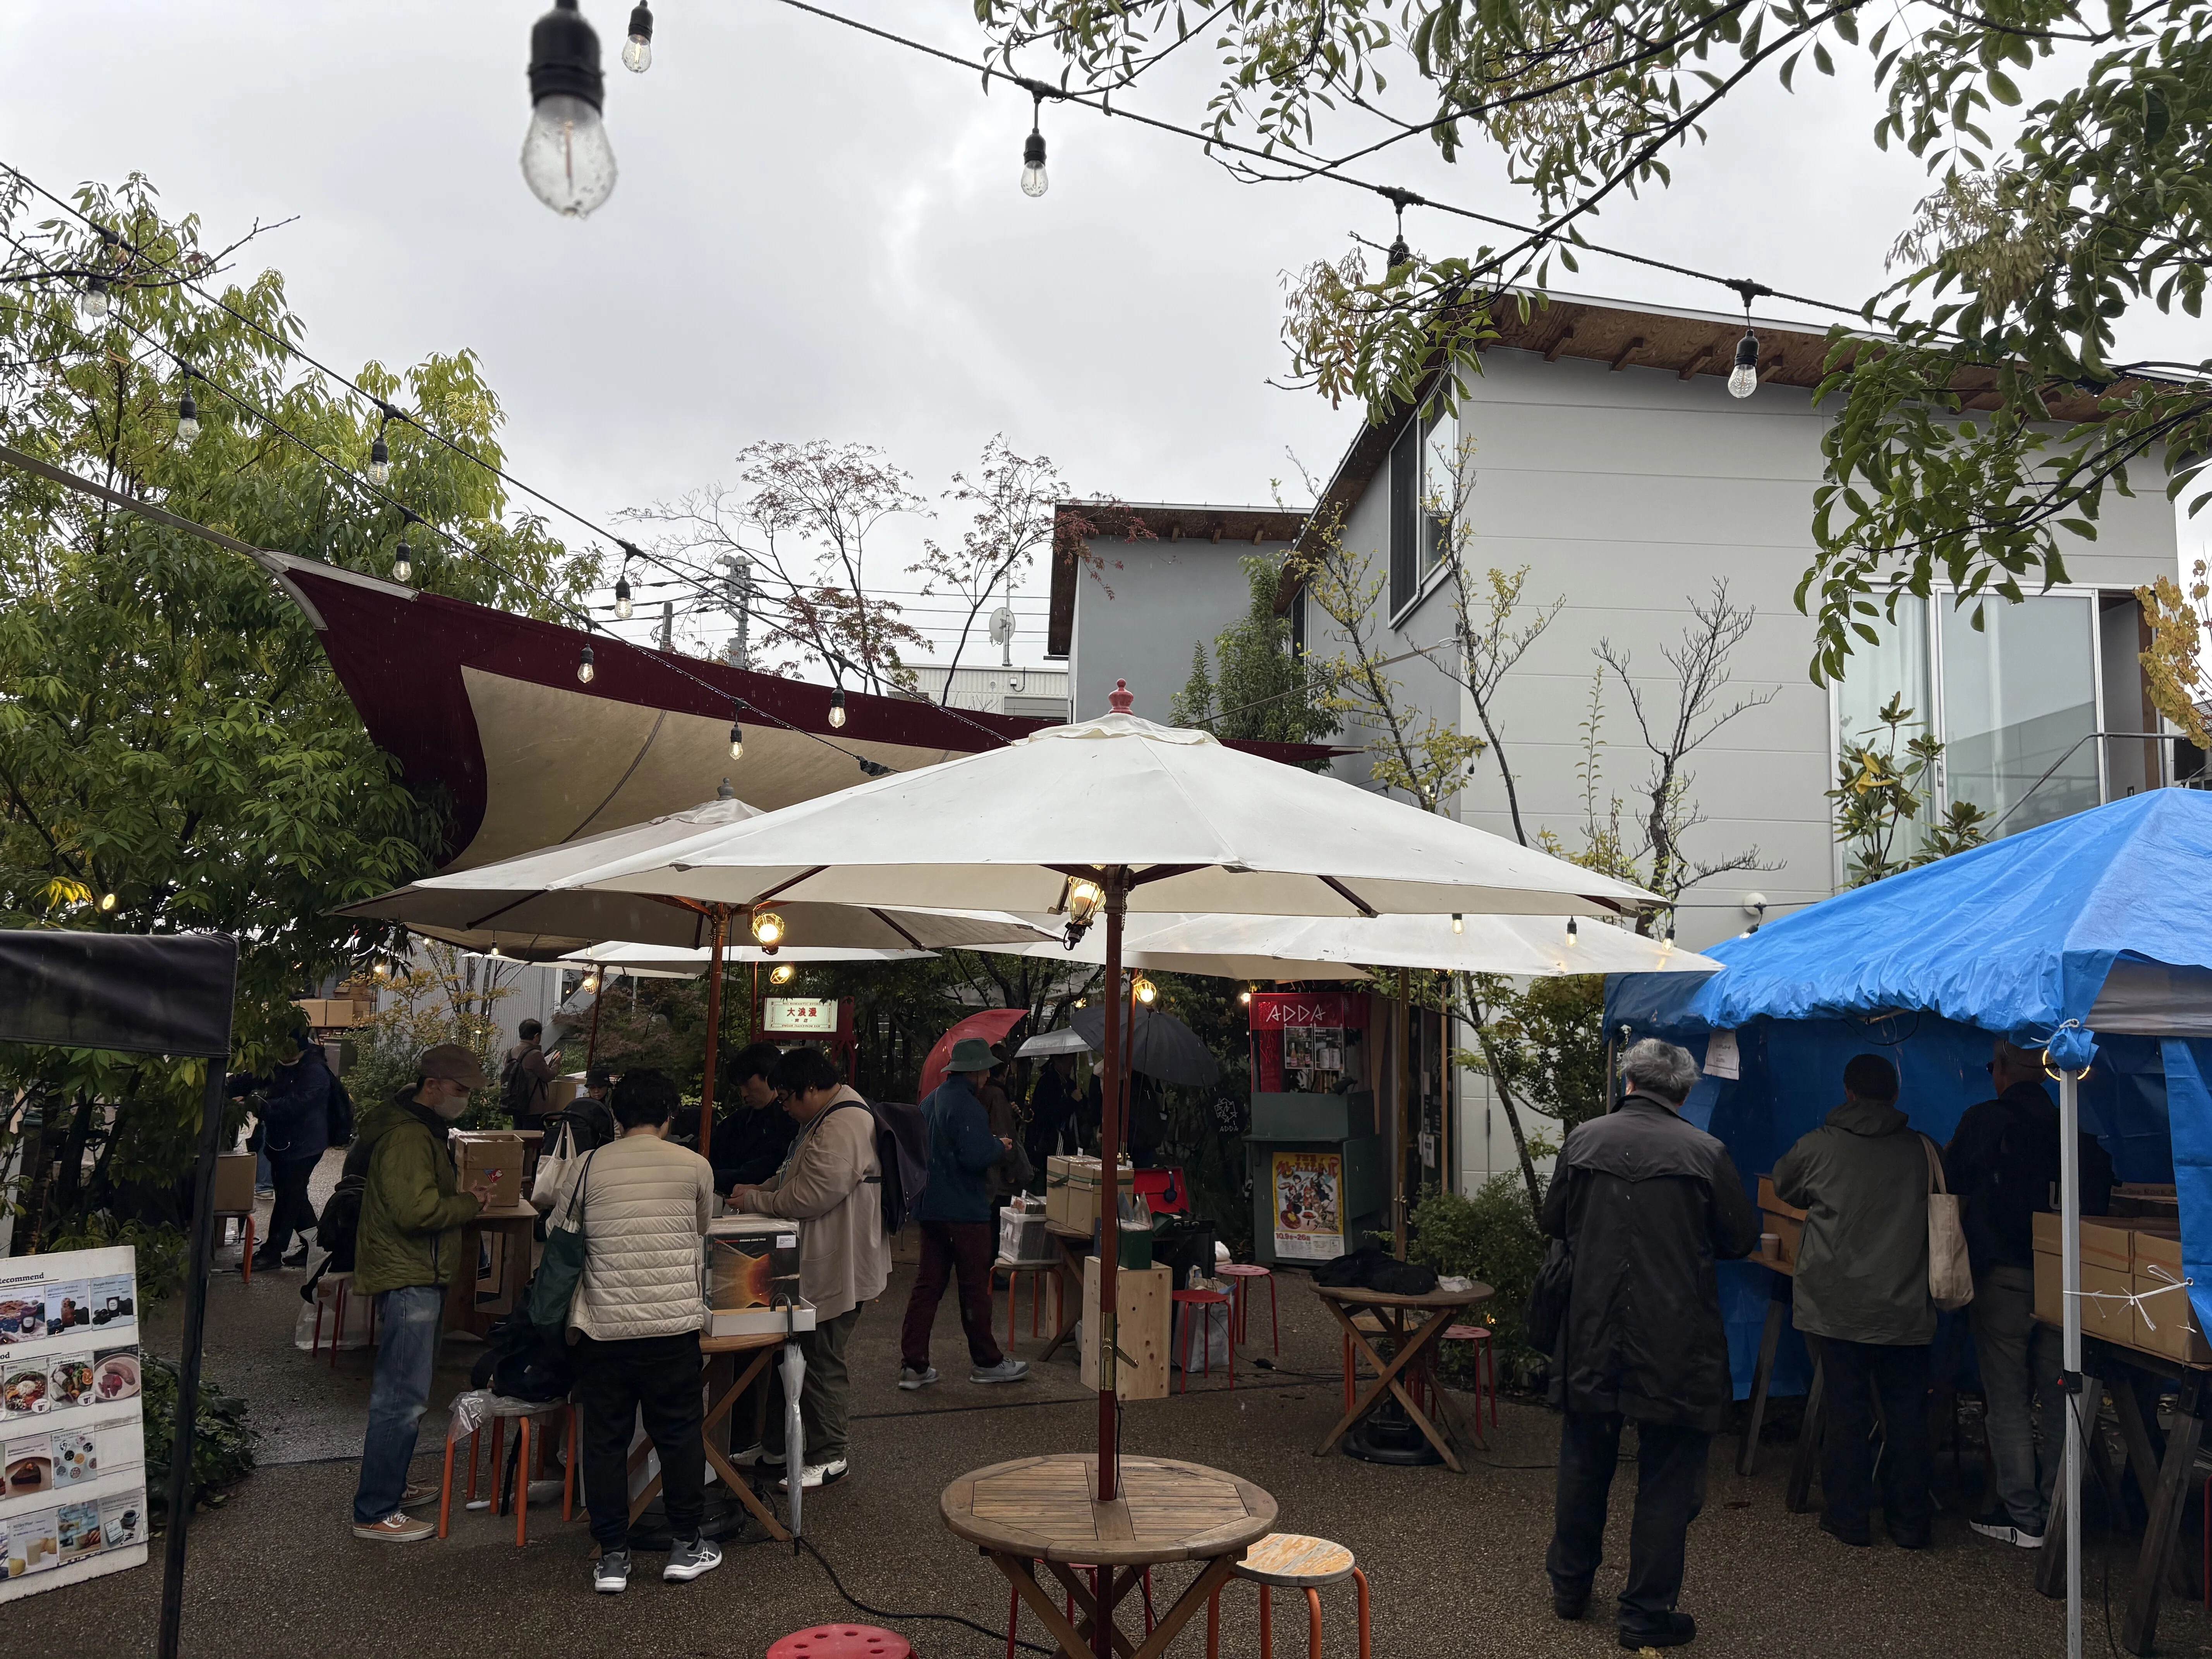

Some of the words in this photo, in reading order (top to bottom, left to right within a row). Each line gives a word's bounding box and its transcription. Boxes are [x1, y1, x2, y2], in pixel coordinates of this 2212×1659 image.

[787, 1007, 817, 1017] 大浪漫
[1266, 1004, 1326, 1022] ADDA
